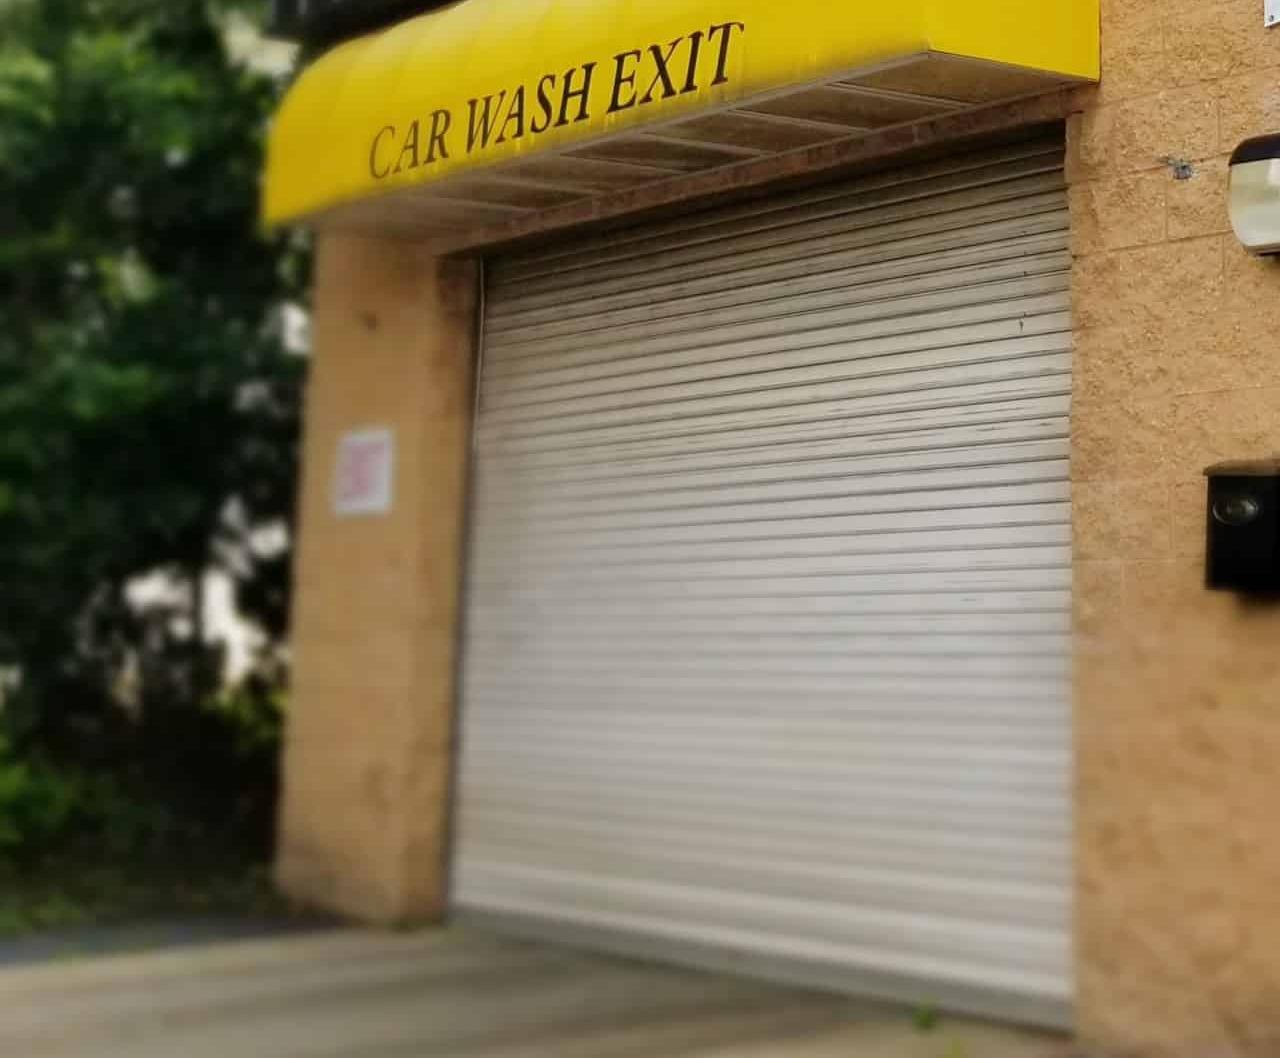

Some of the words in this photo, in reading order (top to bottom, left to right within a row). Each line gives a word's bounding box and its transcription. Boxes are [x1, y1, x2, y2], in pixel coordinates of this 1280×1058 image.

[369, 109, 452, 180] CAR
[465, 61, 598, 154] WASH
[606, 21, 745, 115] EXIT
